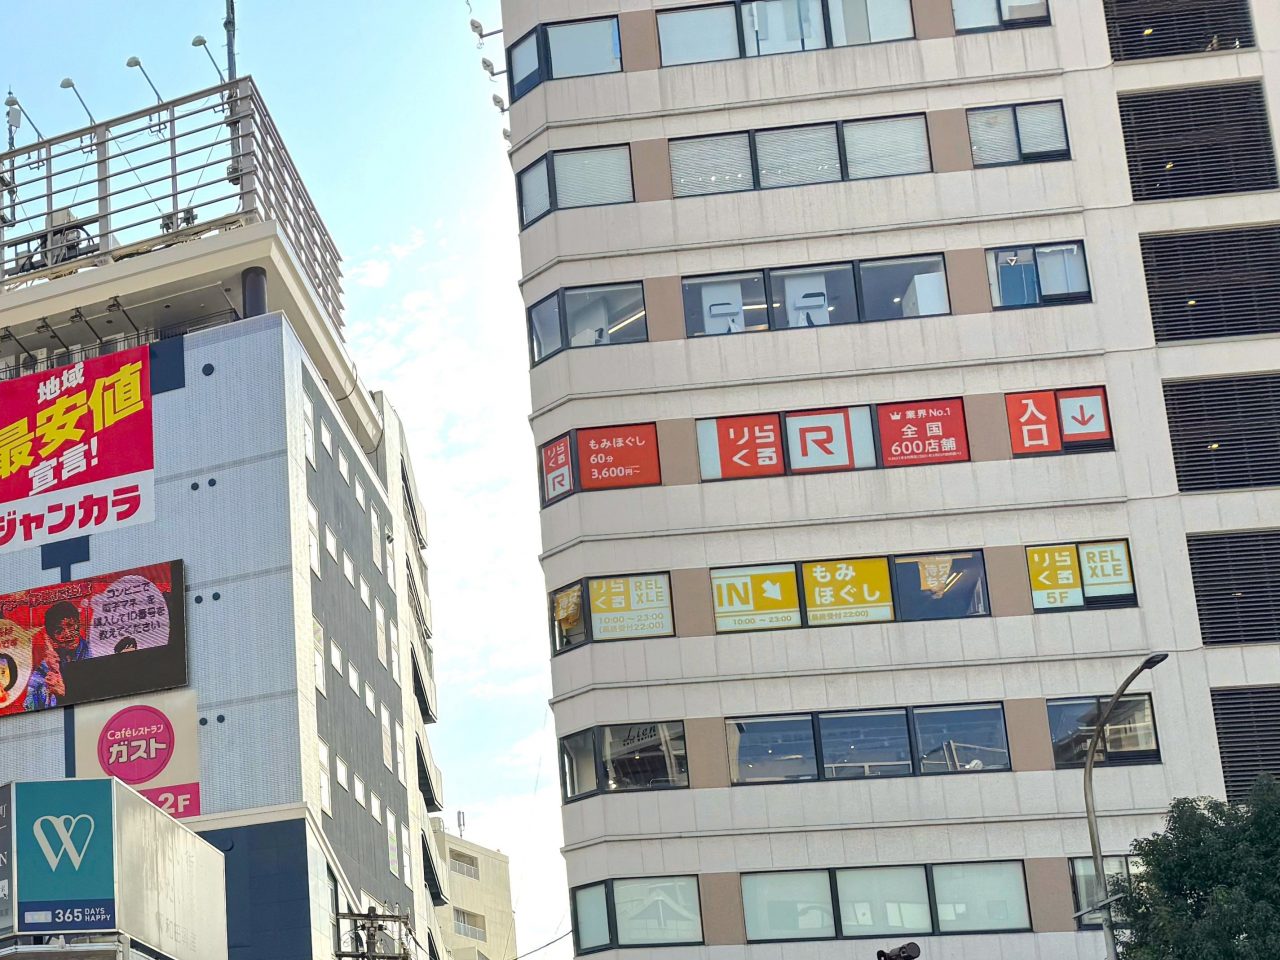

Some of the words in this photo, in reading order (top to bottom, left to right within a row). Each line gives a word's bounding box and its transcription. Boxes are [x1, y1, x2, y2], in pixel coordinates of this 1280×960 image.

[37, 362, 85, 404] 地域
[901, 422, 943, 438] 全国
[1019, 399, 1049, 447] 入口
[589, 435, 645, 449] もみほぐし
[891, 437, 956, 455] 600店舗
[590, 453, 613, 464] 60分
[1085, 550, 1121, 565] REL
[812, 563, 855, 581] もみ
[1090, 564, 1124, 578] XLE
[718, 580, 751, 609] IN
[814, 584, 880, 605] ほぐし
[1046, 591, 1069, 604] 5F
[108, 737, 167, 765] ガスト
[158, 791, 191, 815] 2F
[55, 908, 83, 923] 365
[84, 907, 105, 915] DAYS
[85, 914, 111, 922] HAPPY
